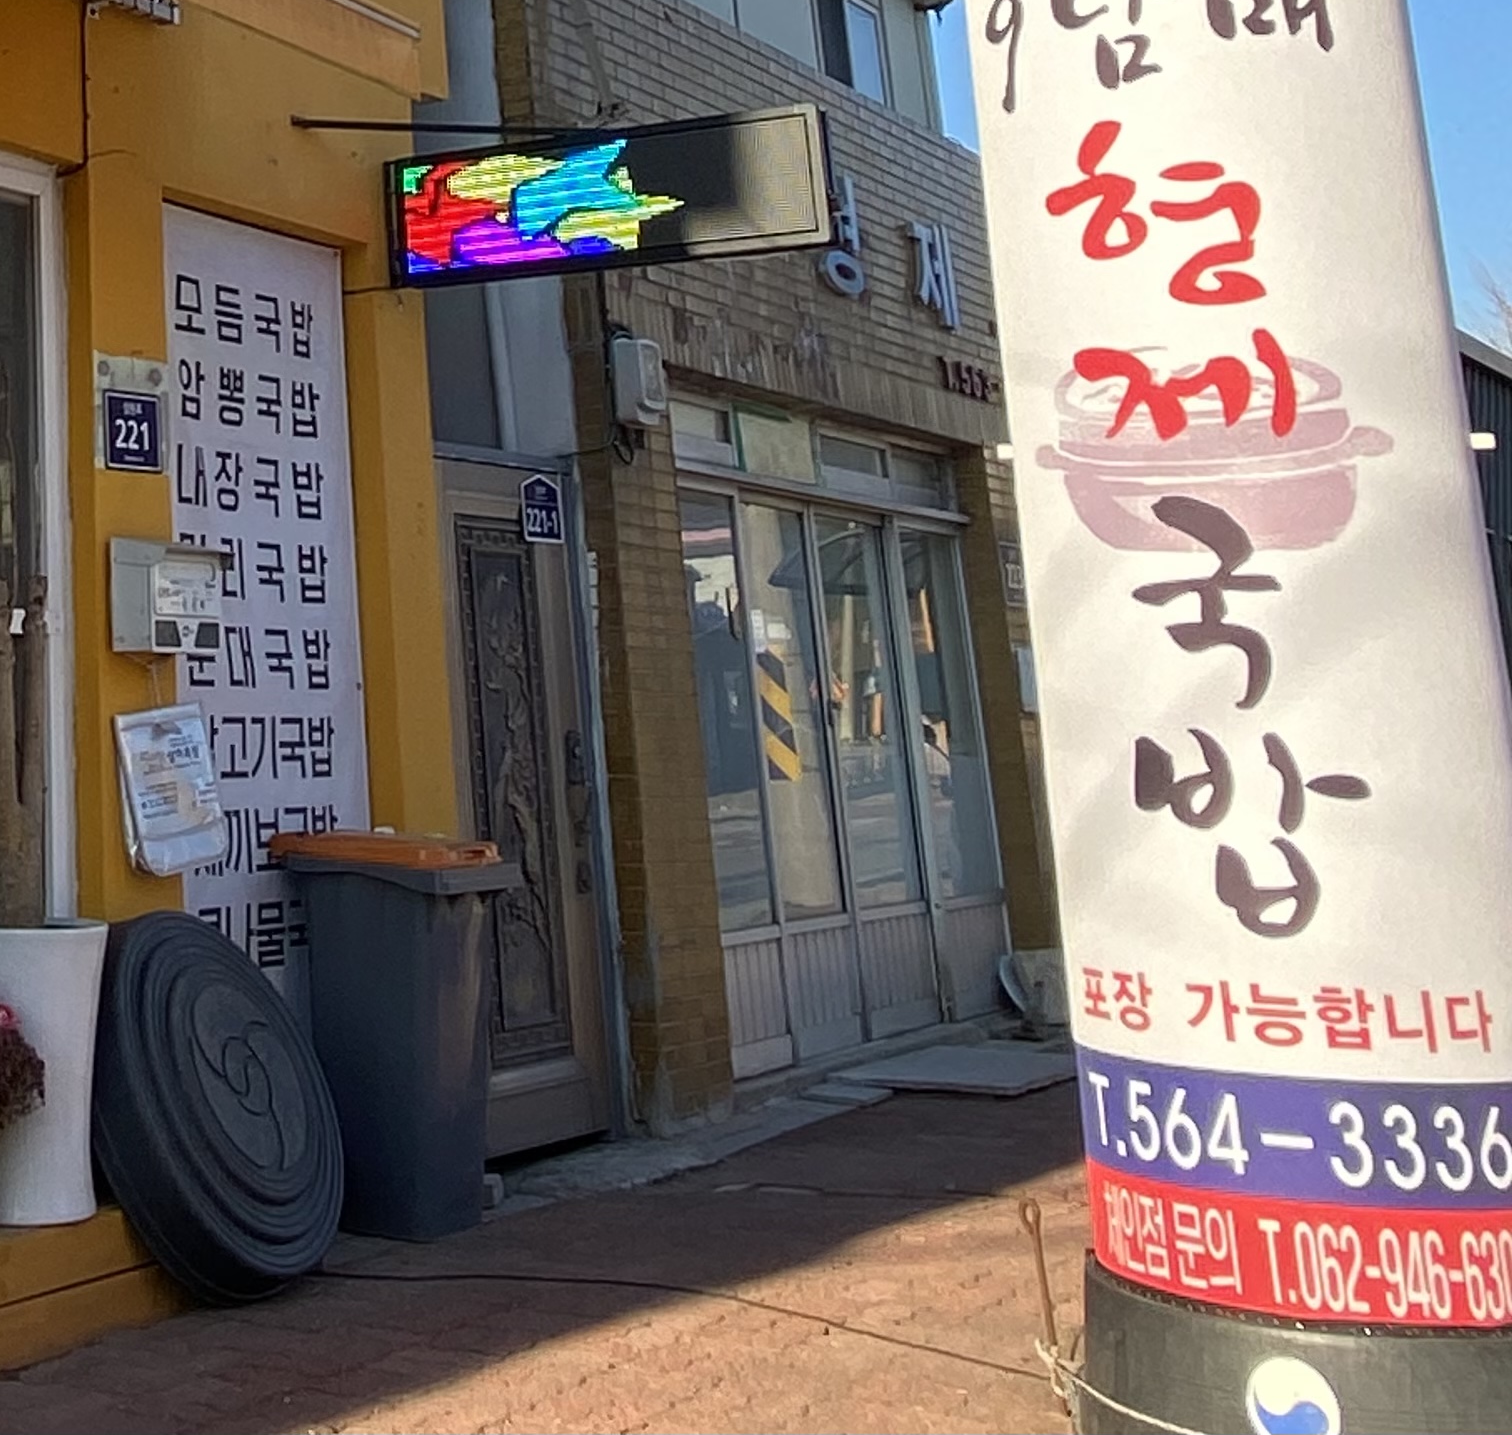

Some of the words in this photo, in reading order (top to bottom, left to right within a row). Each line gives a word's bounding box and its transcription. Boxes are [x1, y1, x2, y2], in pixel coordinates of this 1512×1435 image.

[175, 274, 313, 359] 모듬국밥
[115, 418, 150, 451] 221
[178, 359, 320, 439] 암뽕국밥
[177, 444, 324, 520] 내장국밥
[526, 507, 558, 535] 221-1
[179, 532, 327, 603] 리국밥
[210, 714, 334, 778] 고기국밥
[1083, 967, 1153, 1032] 포장
[1186, 979, 1493, 1053] 가능합니다
